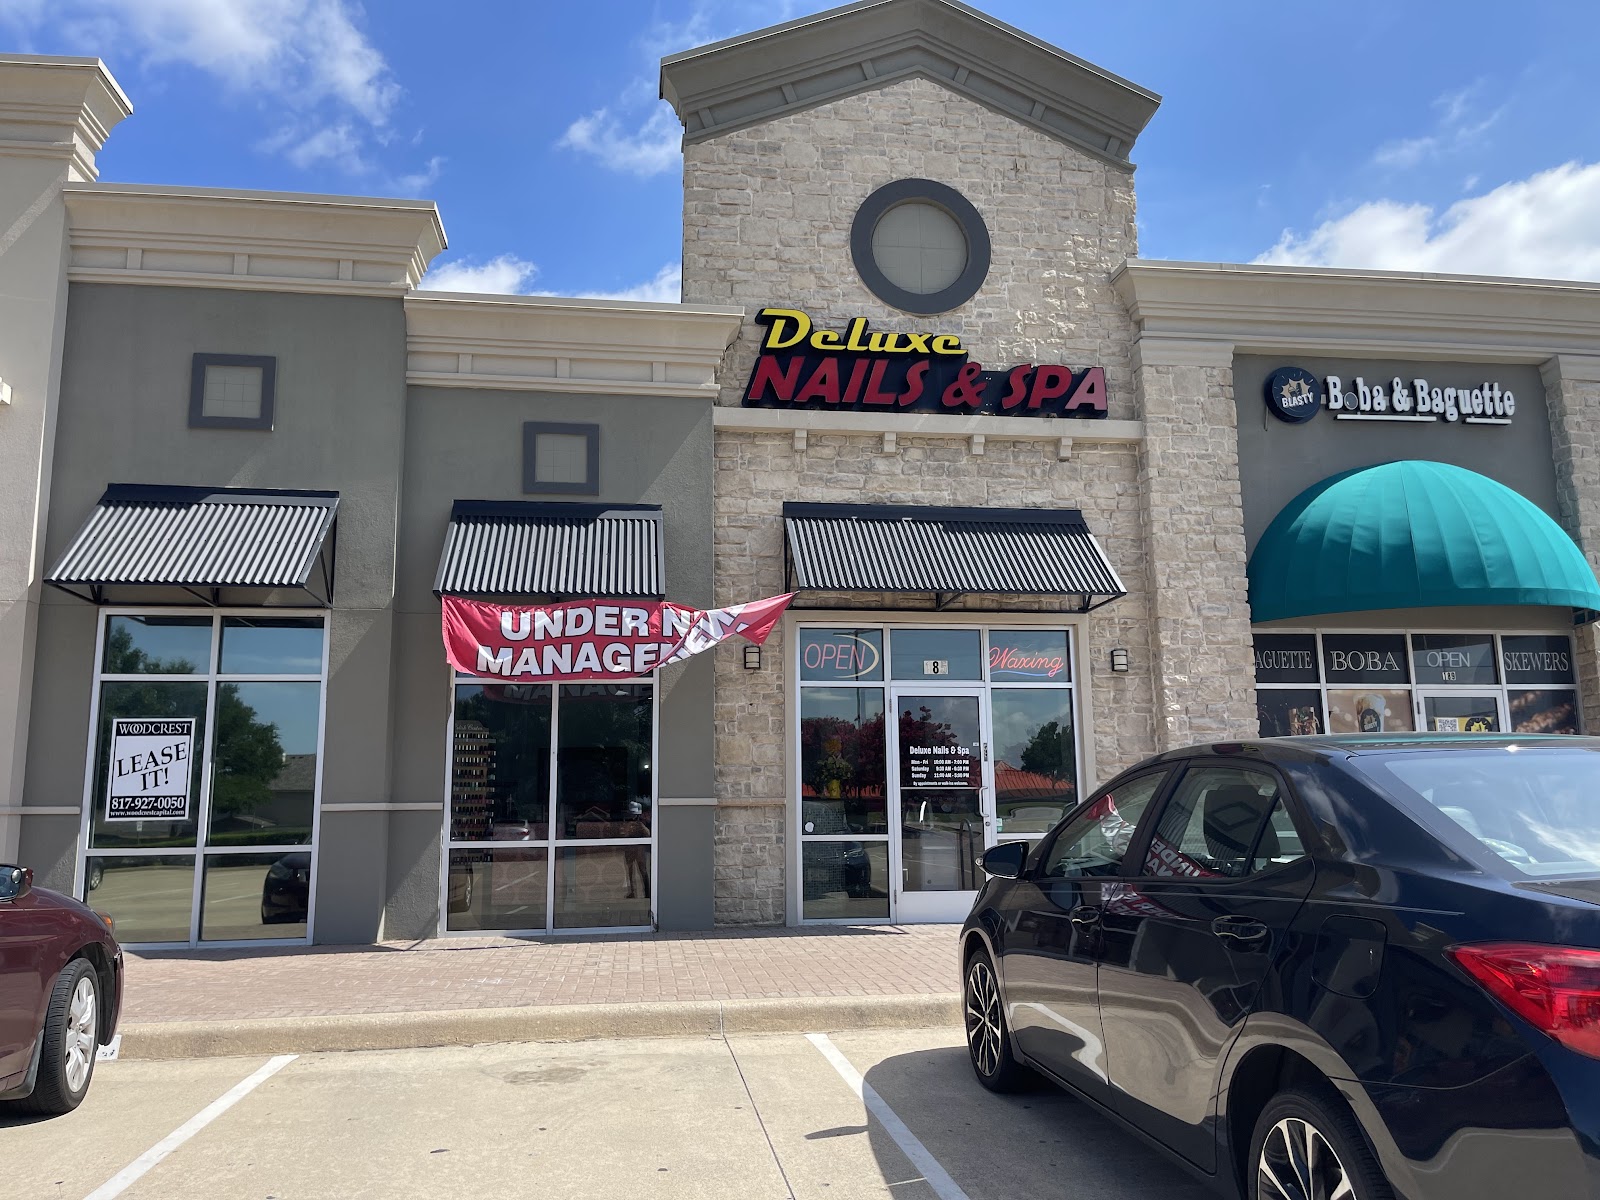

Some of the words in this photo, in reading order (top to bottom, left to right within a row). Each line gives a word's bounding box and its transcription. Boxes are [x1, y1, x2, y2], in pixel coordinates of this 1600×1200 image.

[761, 308, 968, 354] Deluxe
[747, 355, 930, 407] NAILS
[941, 361, 987, 408] &
[1001, 363, 1108, 410] SPA
[1281, 392, 1314, 408] BLASTY
[1326, 375, 1387, 411] Boba
[1391, 376, 1412, 412] &
[1413, 378, 1516, 422] Baguette
[500, 605, 649, 641] UNDER
[476, 642, 675, 676] MANAGE
[804, 643, 867, 670] OPEN
[988, 646, 1064, 677] Waxing
[1254, 650, 1313, 669] AGUETTE
[1331, 650, 1400, 672] BOBA
[1426, 651, 1471, 668] OPEN
[1504, 651, 1569, 672] SKEWERS
[118, 723, 191, 735] WOODCREST
[116, 741, 187, 778] LEASE
[909, 746, 932, 755] Deluxe
[933, 746, 949, 755] Nails
[957, 746, 970, 757] Spa
[140, 766, 169, 792] IT!
[110, 809, 185, 817] www.woodcrestcapital.com
[111, 797, 185, 809] 817-927-0050
